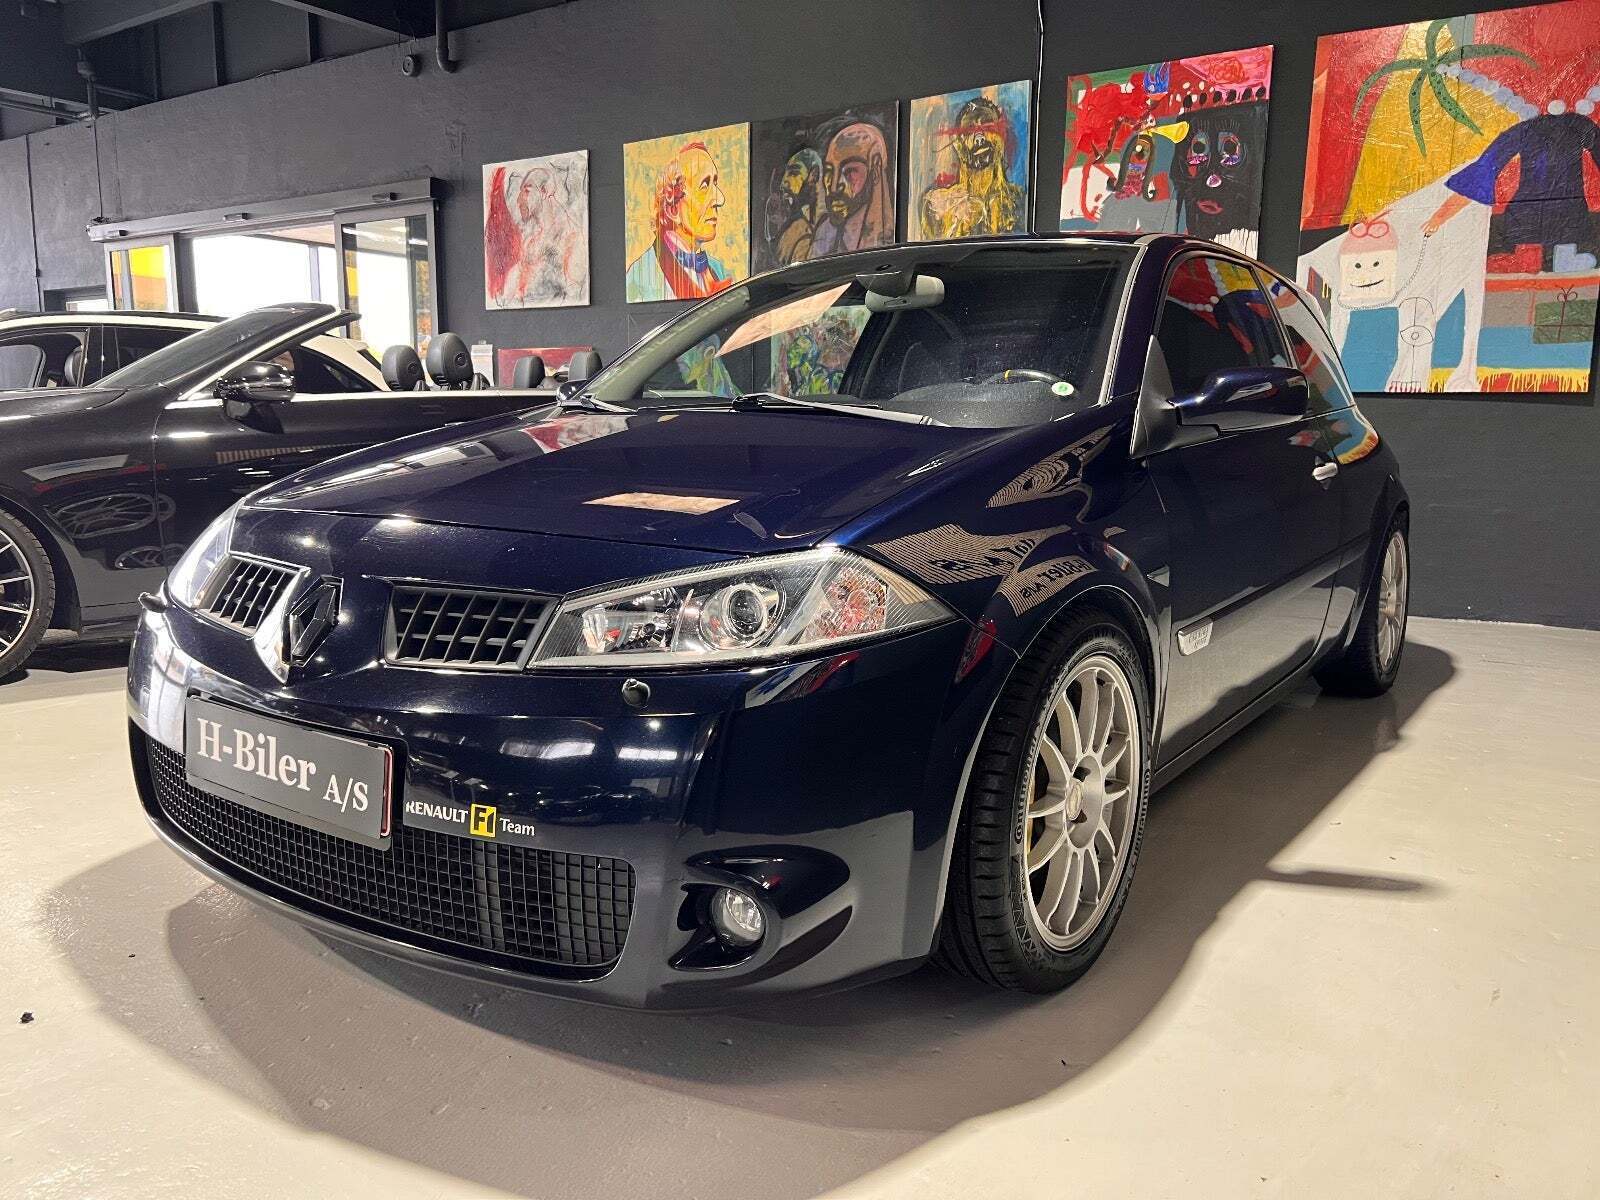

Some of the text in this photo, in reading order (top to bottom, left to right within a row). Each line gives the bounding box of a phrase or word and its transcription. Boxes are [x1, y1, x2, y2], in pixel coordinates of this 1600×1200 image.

[196, 717, 370, 813] H-Biler A/S
[405, 800, 536, 837] RENAULT F1 Team
